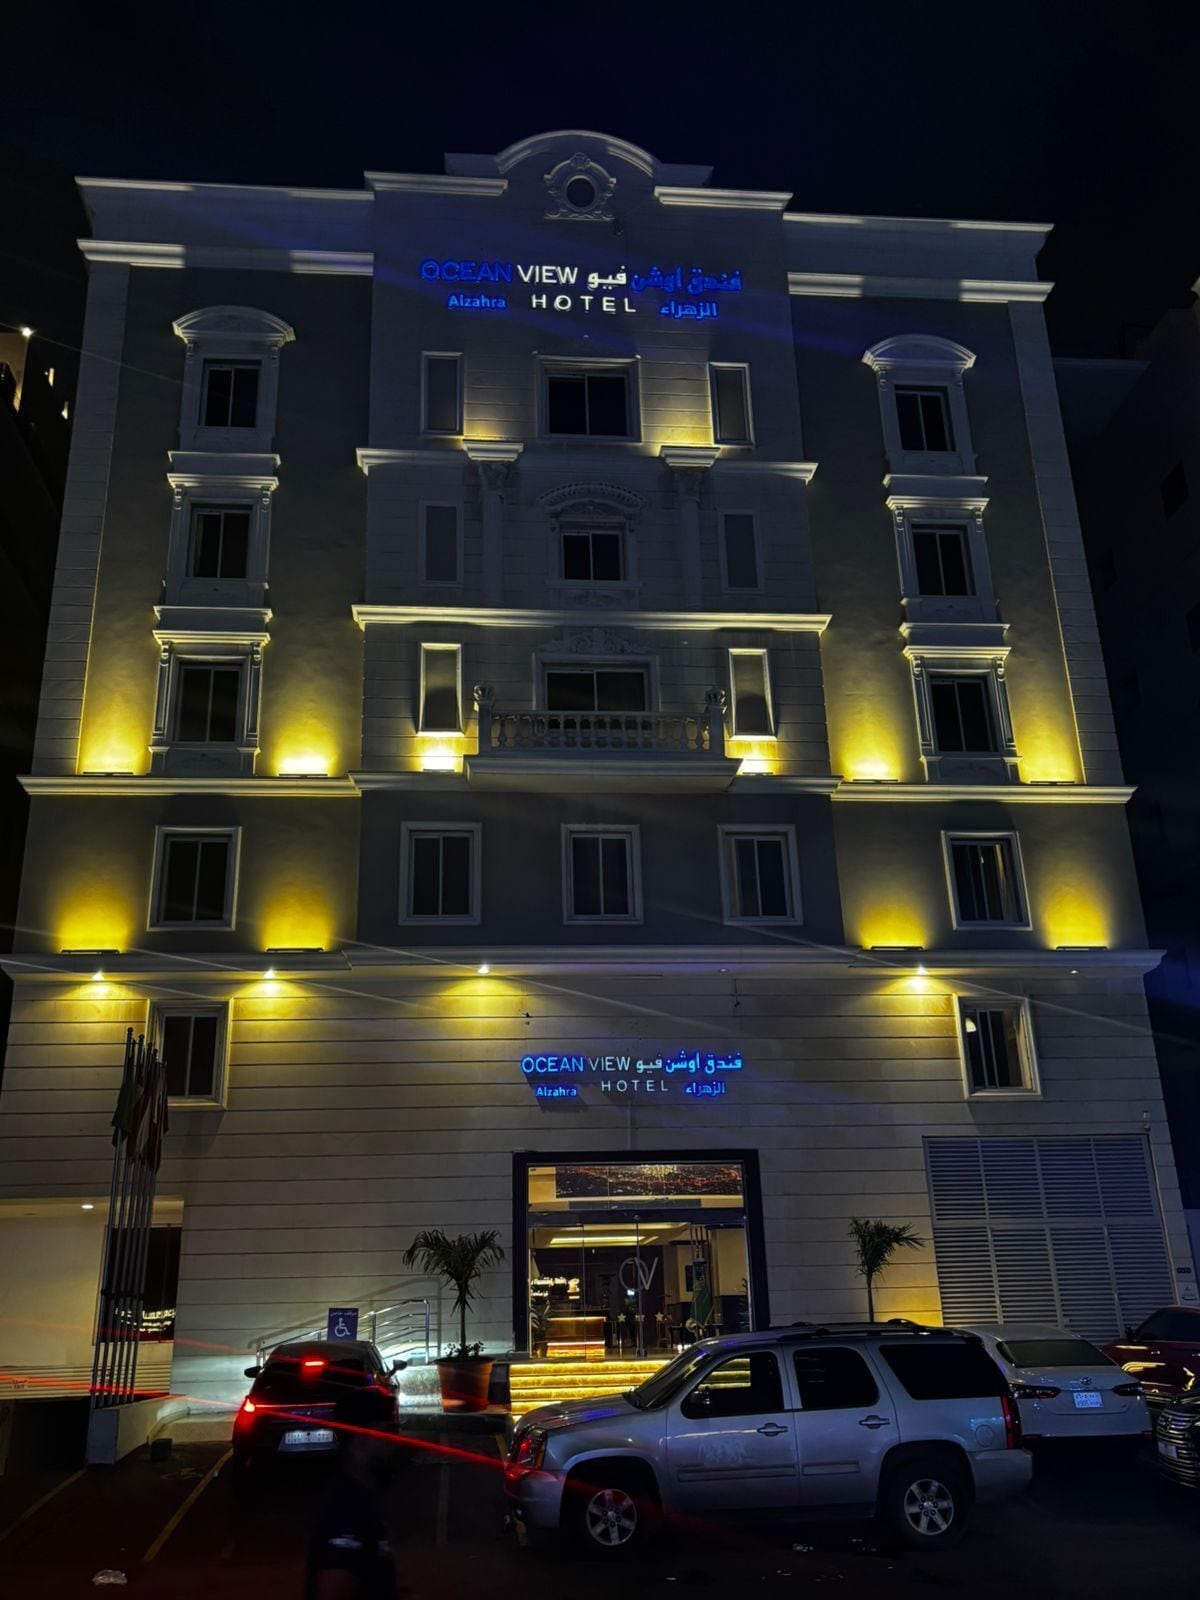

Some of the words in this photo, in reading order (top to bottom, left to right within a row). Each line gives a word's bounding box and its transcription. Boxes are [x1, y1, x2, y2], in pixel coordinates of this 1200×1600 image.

[421, 259, 511, 283] OCEAN
[517, 265, 578, 285] VIEW
[587, 265, 627, 289] فيو
[687, 267, 742, 294] فندق
[448, 294, 506, 309] Alzahra
[531, 294, 637, 313] HOTEL
[660, 301, 718, 320] الزهراء
[521, 1056, 583, 1073] OCEAN
[589, 1056, 630, 1072] VIEW
[636, 1053, 663, 1073] فيو
[704, 1052, 742, 1074] فندق
[536, 1086, 577, 1097] Alzahra
[601, 1079, 669, 1092] HOTEL
[686, 1082, 725, 1097] الزهراء
